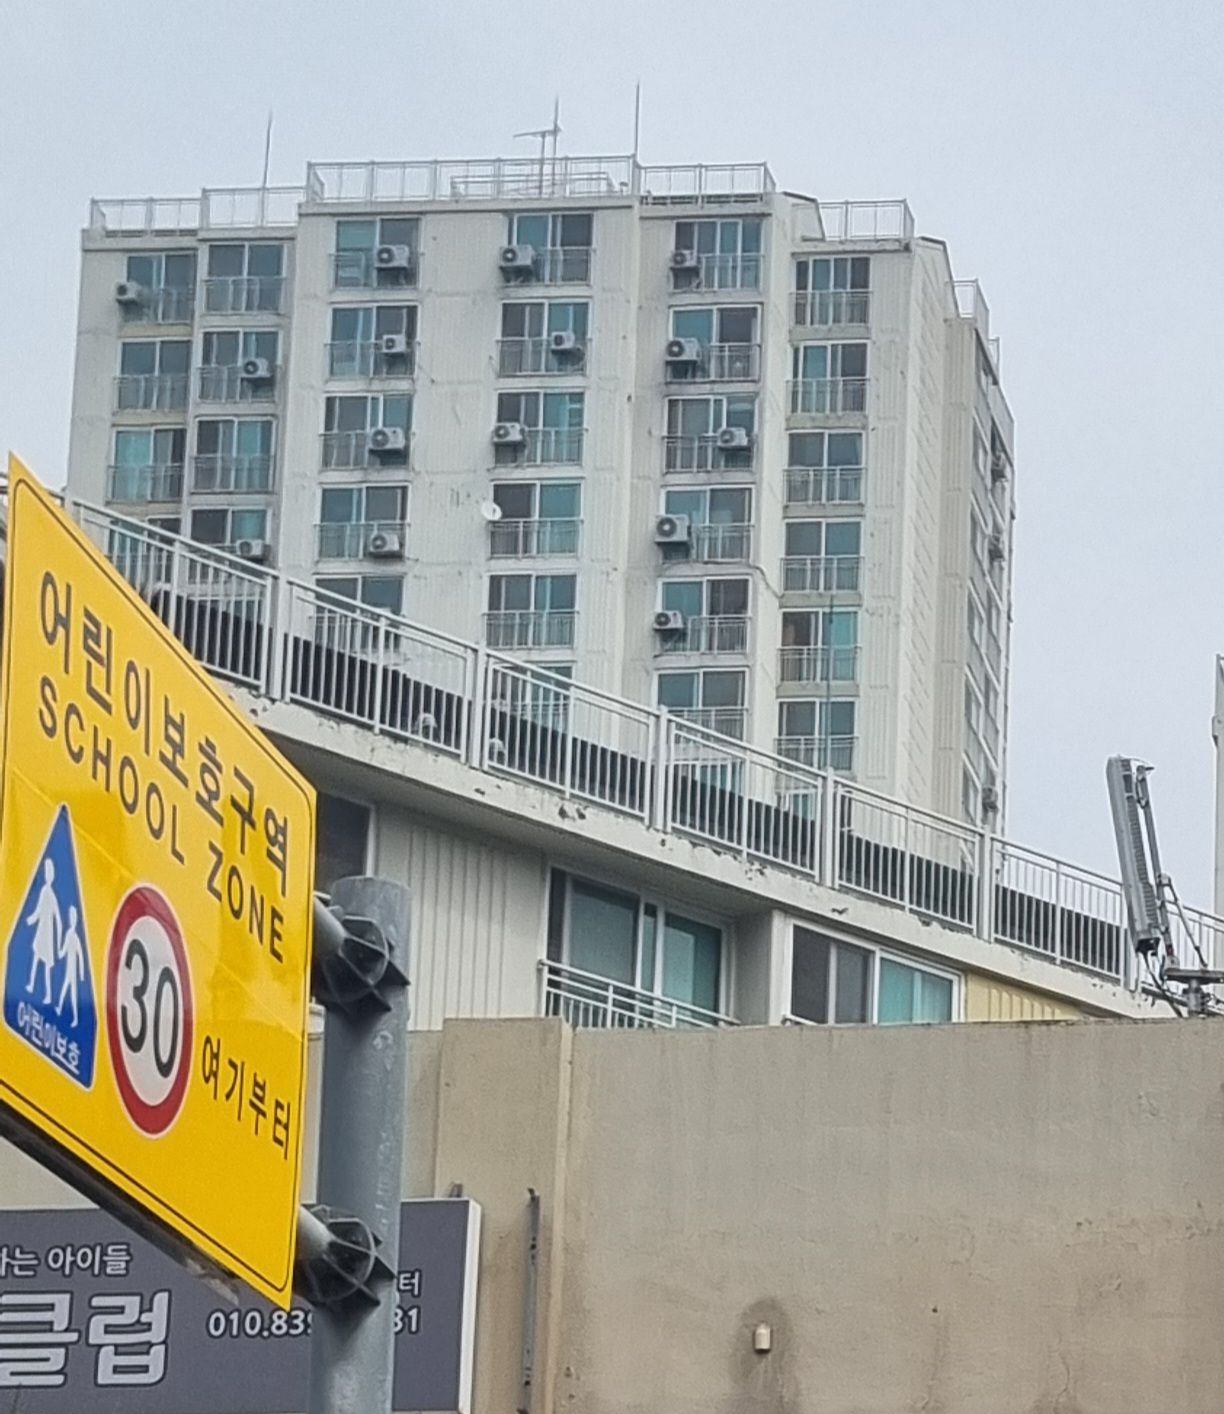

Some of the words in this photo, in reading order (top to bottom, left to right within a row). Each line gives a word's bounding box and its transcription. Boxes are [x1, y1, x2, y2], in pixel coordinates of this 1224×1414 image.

[39, 570, 289, 897] 어린이보호구역
[38, 675, 186, 866] SCHOOL
[207, 850, 285, 964] ZONE
[17, 1000, 80, 1075] 어린이보호
[119, 938, 179, 1079] 30
[202, 1035, 290, 1161] 여기부터
[47, 1244, 131, 1276] 아이들
